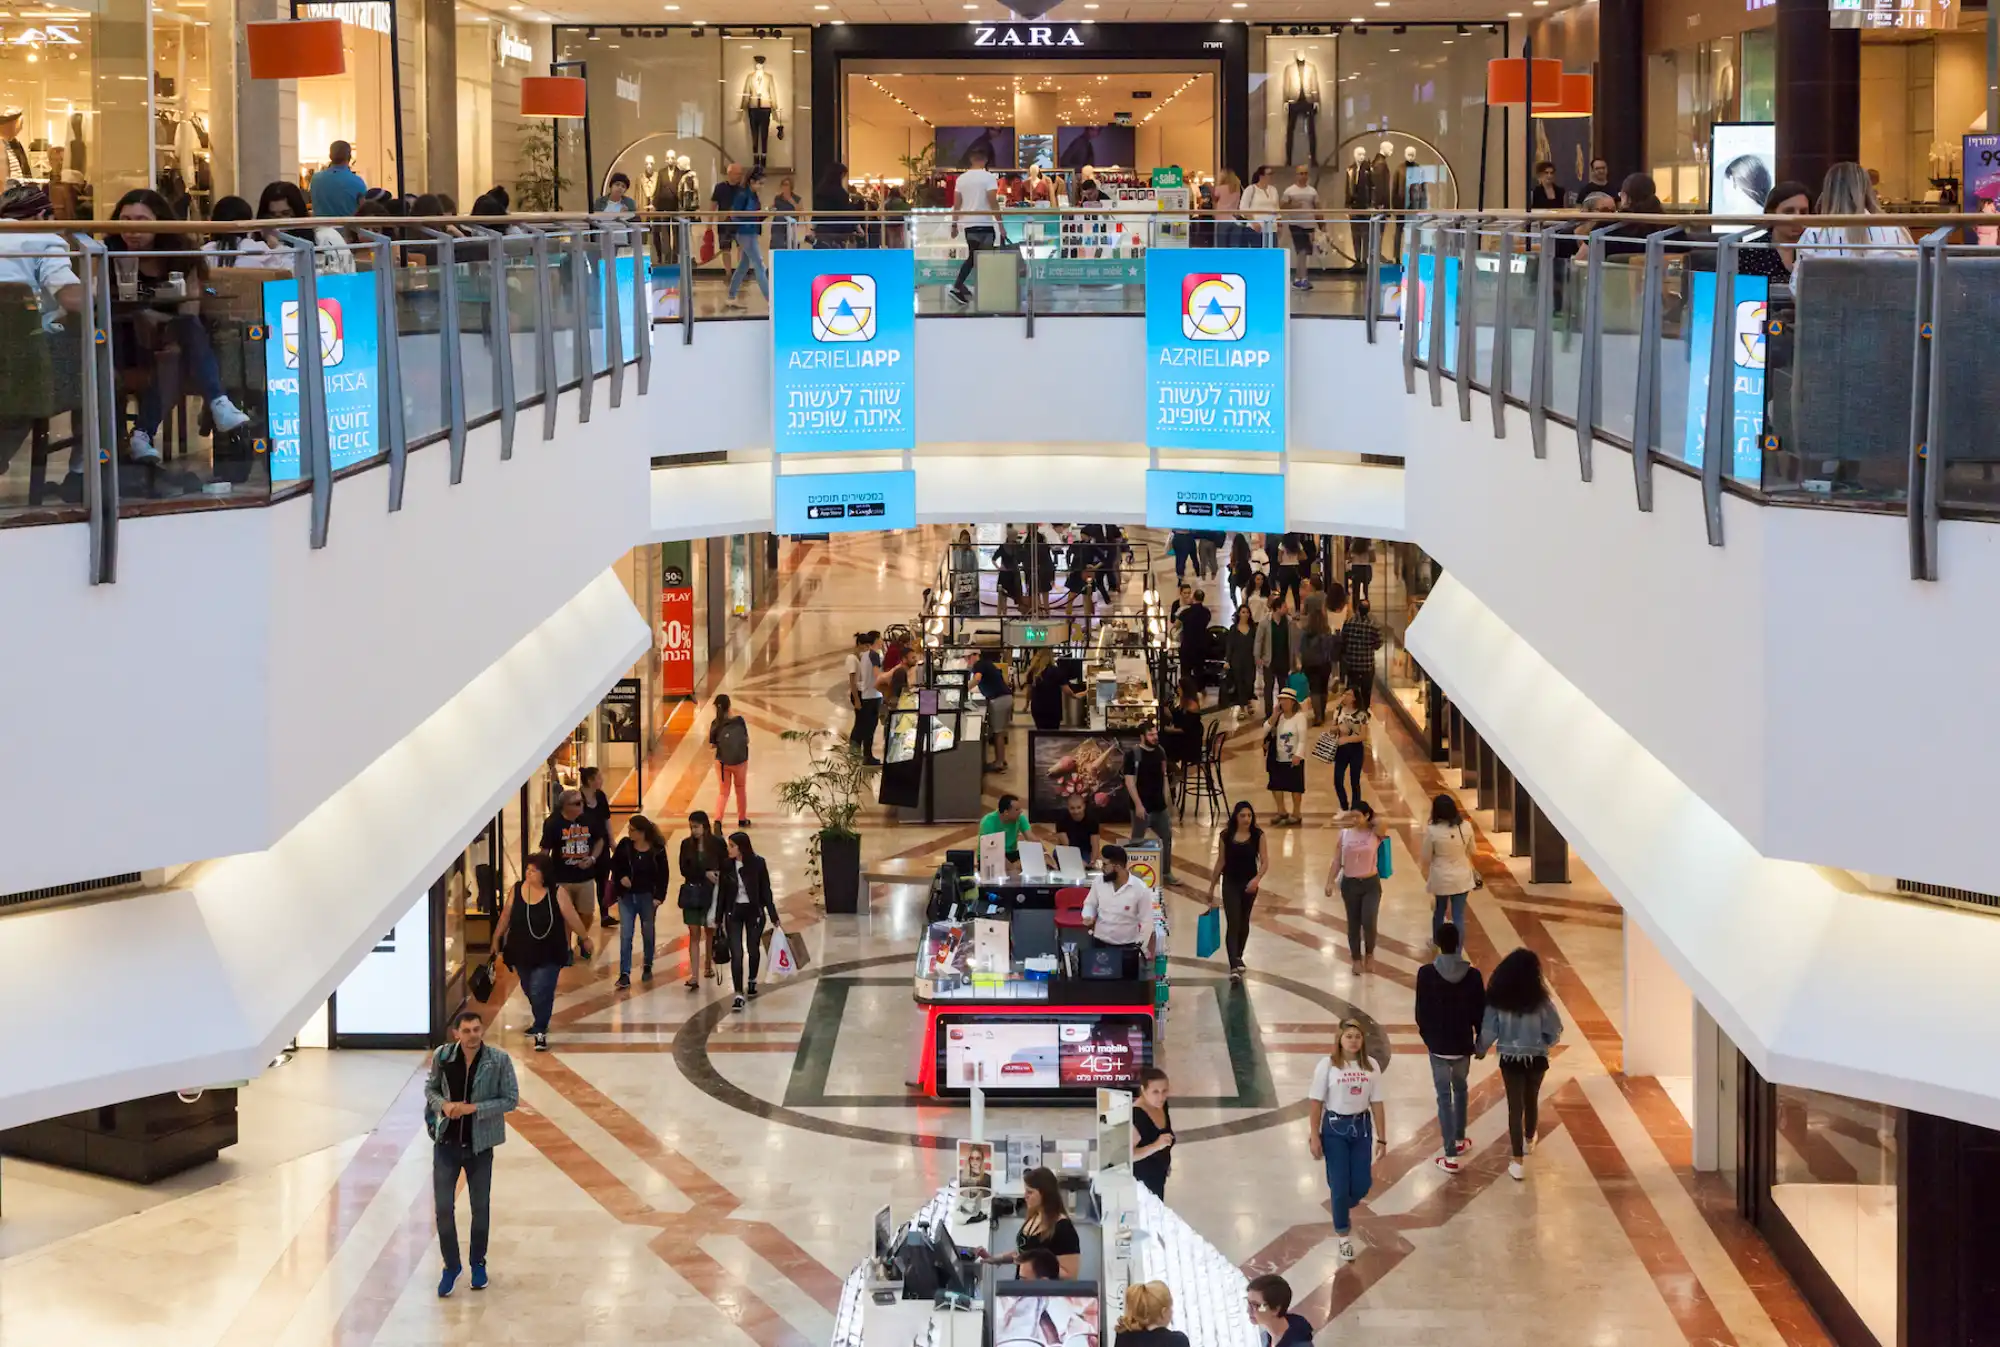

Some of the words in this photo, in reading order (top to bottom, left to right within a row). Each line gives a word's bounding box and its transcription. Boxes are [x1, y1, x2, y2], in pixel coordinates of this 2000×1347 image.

[974, 27, 1085, 46] ZARA
[1159, 171, 1177, 184] sale
[788, 349, 901, 369] AZRIELIAPP
[1160, 347, 1271, 368] AZRIELIAPP
[788, 384, 853, 409] לעשות
[859, 387, 901, 406] שווה
[1158, 383, 1222, 407] לעשות
[1228, 388, 1271, 407] שווה
[788, 410, 847, 429] שופינג
[854, 407, 902, 427] איתה
[1158, 406, 1216, 426] שופינג
[1223, 408, 1271, 428] איתה
[661, 592, 692, 602] EPLAY
[1078, 1045, 1096, 1053] HOT
[1097, 1044, 1128, 1053] mobile
[1080, 1054, 1125, 1073] 4G+
